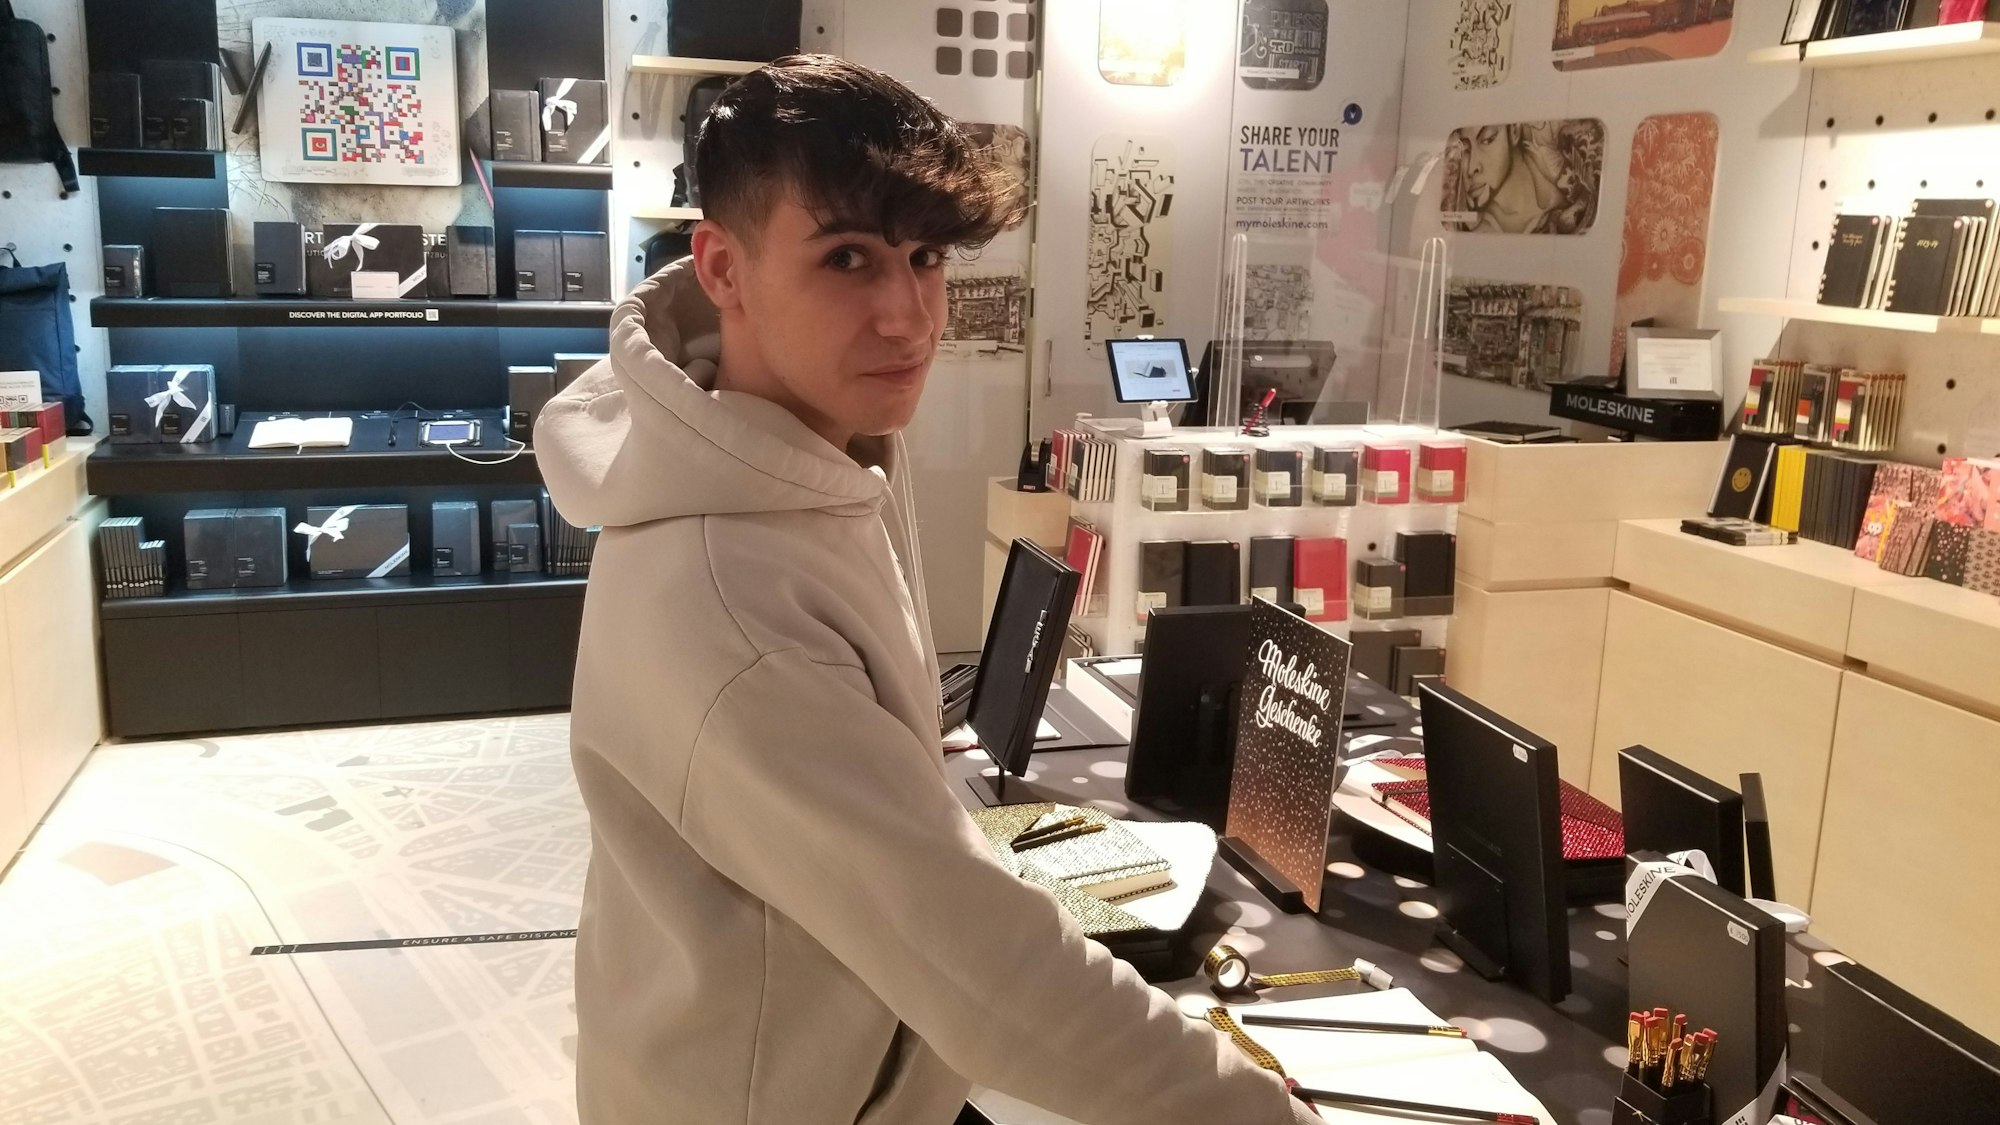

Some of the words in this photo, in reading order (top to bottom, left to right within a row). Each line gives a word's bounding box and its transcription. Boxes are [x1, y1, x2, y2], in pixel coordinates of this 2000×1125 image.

[1272, 29, 1294, 39] THE
[1269, 39, 1295, 54] TO
[1240, 125, 1292, 146] SHARE
[1298, 127, 1340, 147] YOUR
[1240, 148, 1338, 174] TALENT
[1236, 196, 1257, 205] POST
[1260, 197, 1283, 205] YOUR
[1286, 198, 1331, 206] ARTWORKS
[1236, 216, 1328, 232] mymoleskine.com
[304, 231, 324, 245] RT
[422, 233, 447, 247] STE
[289, 311, 325, 319] DISCOVER
[326, 311, 341, 319] THE
[342, 311, 369, 319] DIGITAL
[1566, 393, 1655, 424] MOLESKINE
[1258, 639, 1331, 711] Moleskine
[1255, 685, 1322, 748] Geschenke
[402, 937, 458, 945] ENSURE
[519, 931, 578, 939] DISTANC
